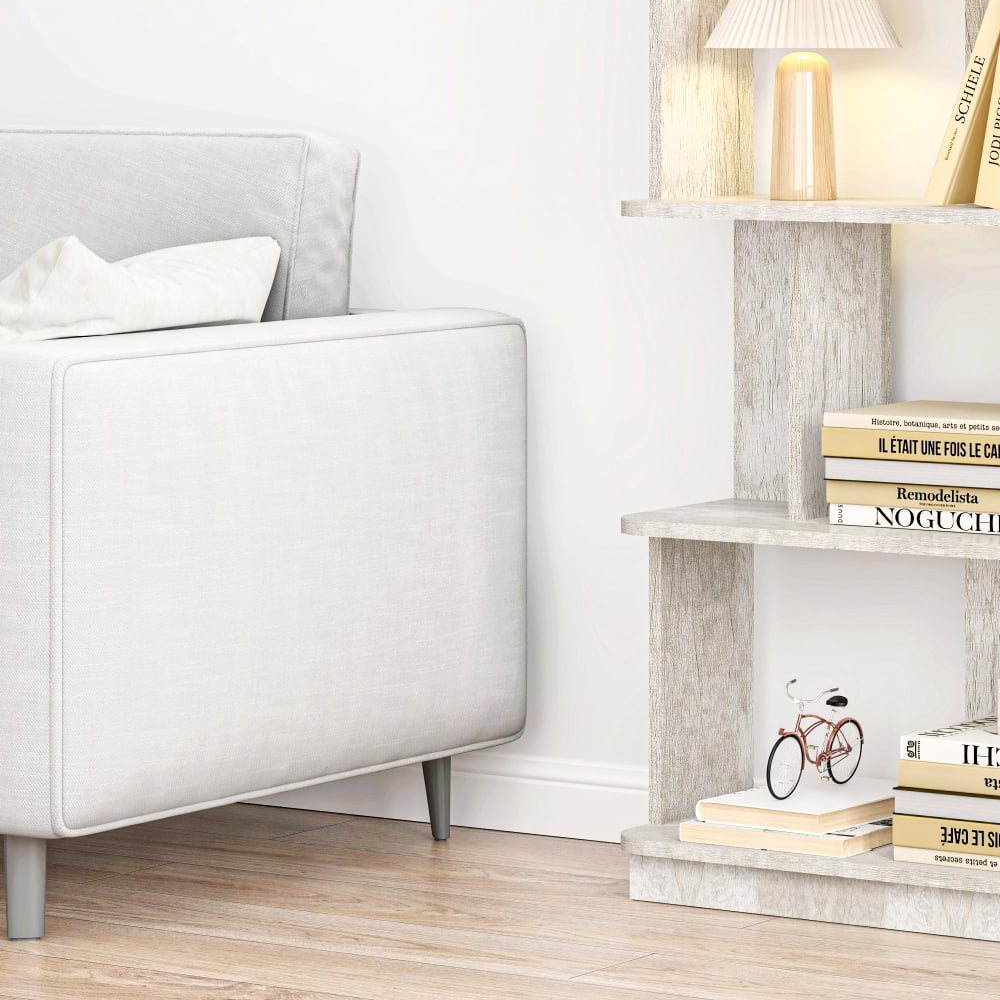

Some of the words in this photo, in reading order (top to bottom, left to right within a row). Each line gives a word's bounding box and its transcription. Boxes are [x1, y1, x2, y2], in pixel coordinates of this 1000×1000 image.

[954, 55, 986, 124] SCHIELE
[871, 418, 902, 428] Histoire,
[903, 418, 941, 430] botanique,
[942, 421, 958, 430] arts
[959, 422, 967, 430] et
[968, 423, 990, 433] petits
[878, 437, 888, 454] IL
[890, 435, 919, 456] ÉTAIT
[921, 439, 942, 456] UNE
[944, 441, 967, 457] FOIS
[969, 443, 982, 458] LE
[896, 487, 979, 505] Remodelista
[940, 826, 969, 847] CAFÉ
[971, 829, 985, 846] LE
[934, 855, 963, 865] secrets
[965, 857, 988, 868] petits
[990, 859, 998, 867] et
